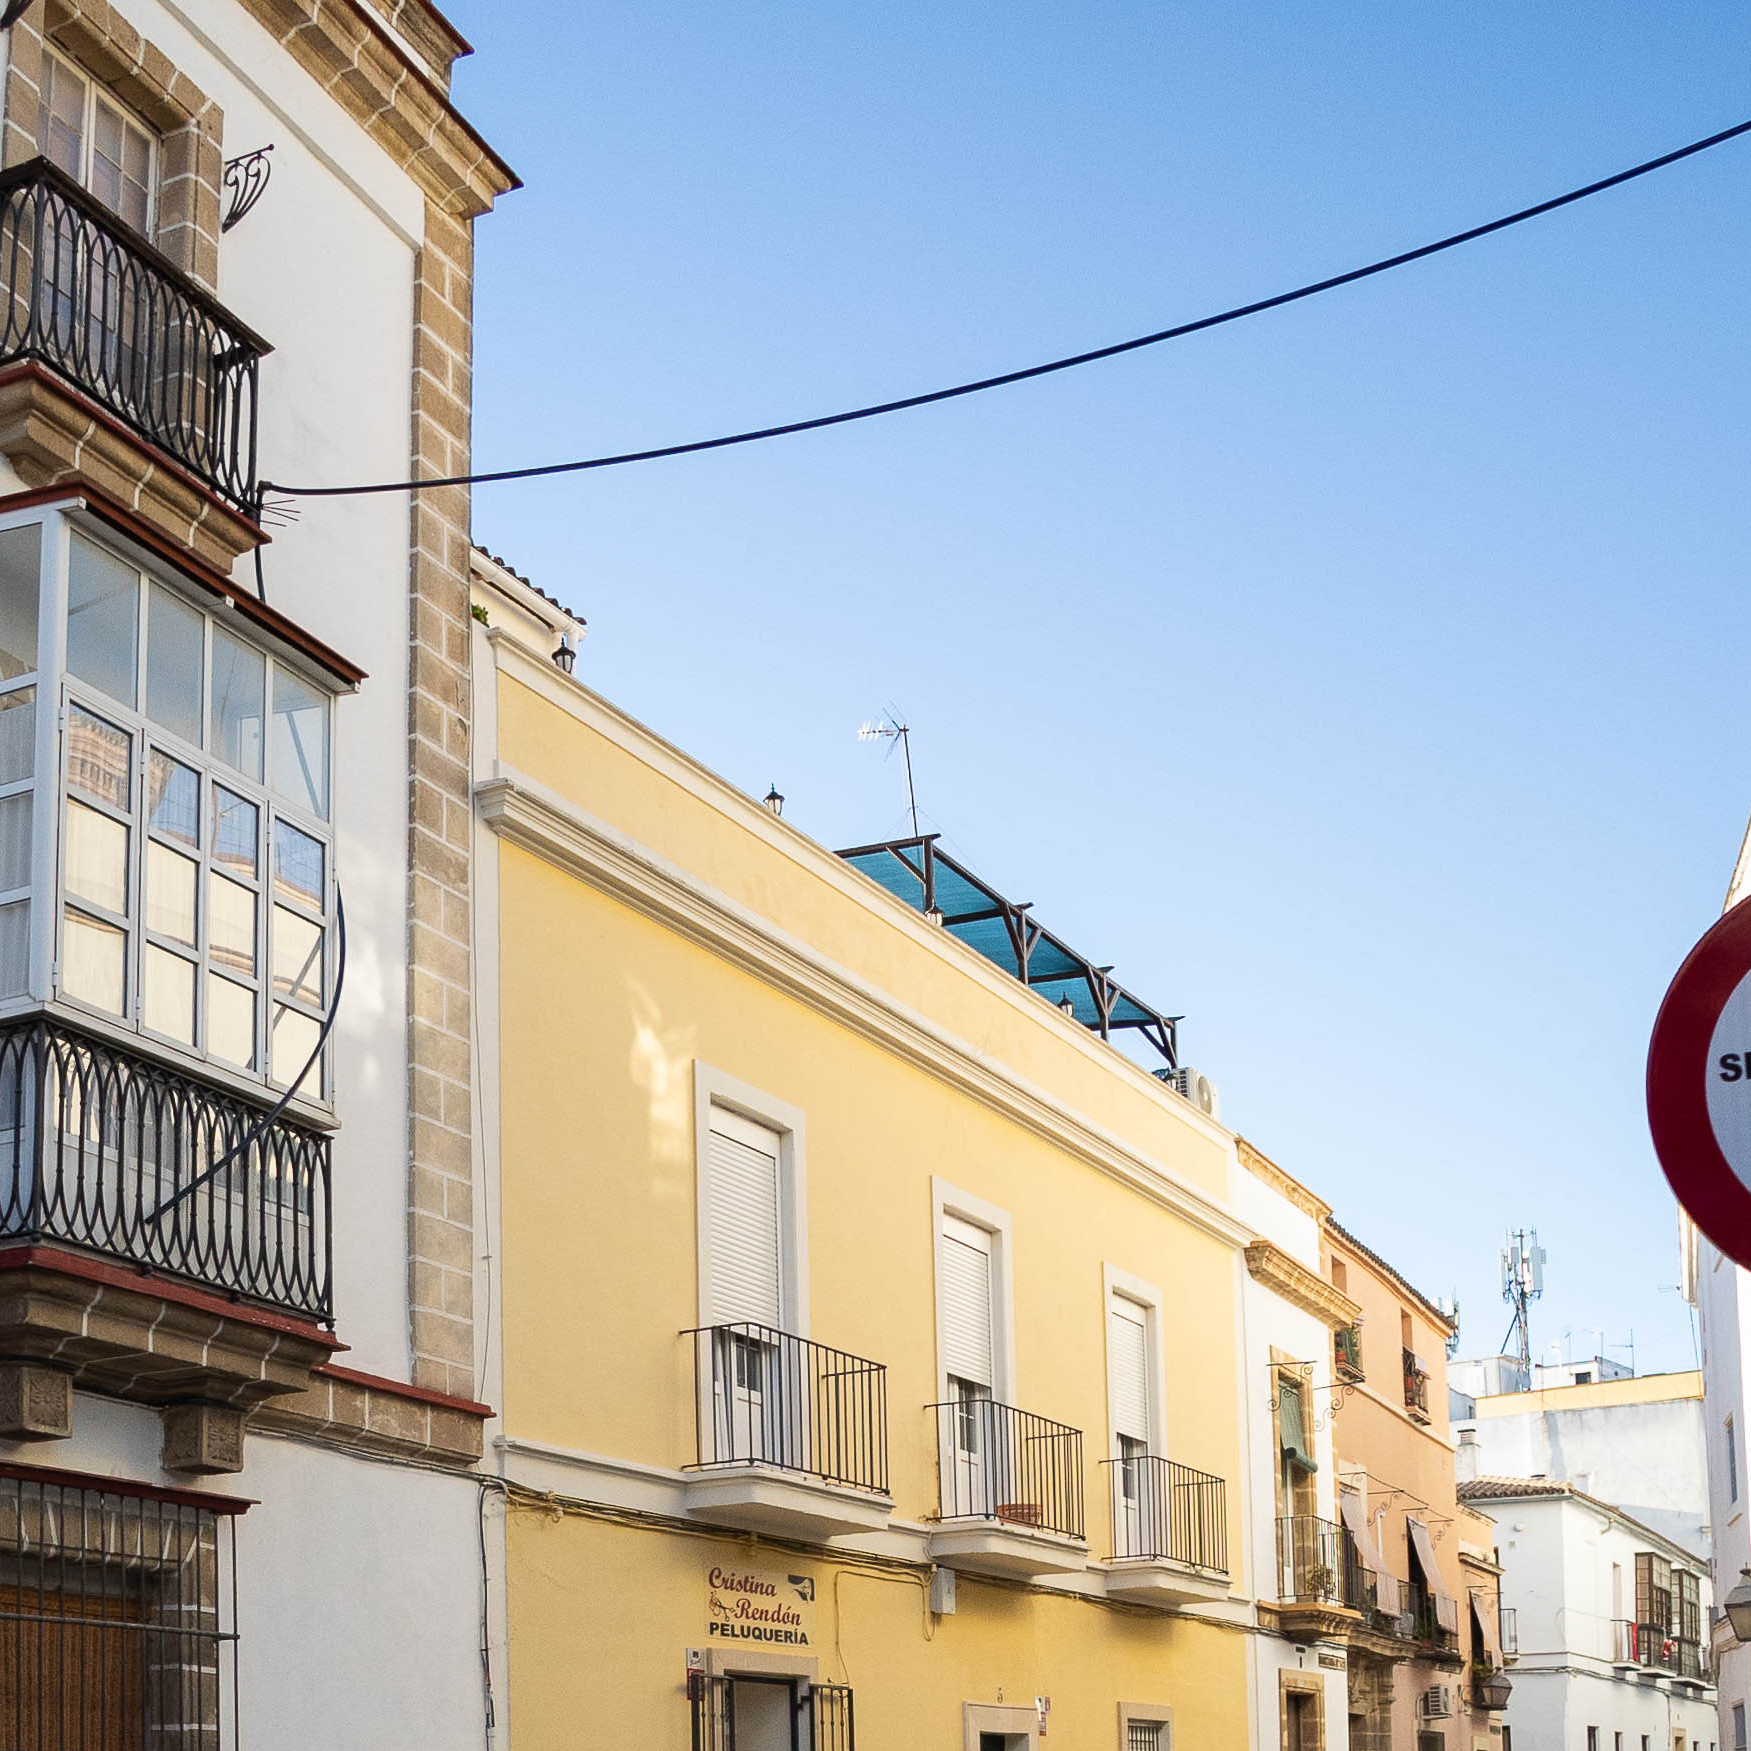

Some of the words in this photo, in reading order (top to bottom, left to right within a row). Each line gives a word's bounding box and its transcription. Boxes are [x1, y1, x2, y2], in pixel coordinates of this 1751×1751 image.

[708, 1567, 777, 1597] Cristina
[734, 1598, 802, 1626] Rendón
[709, 1622, 809, 1645] PELUQUERÍA
